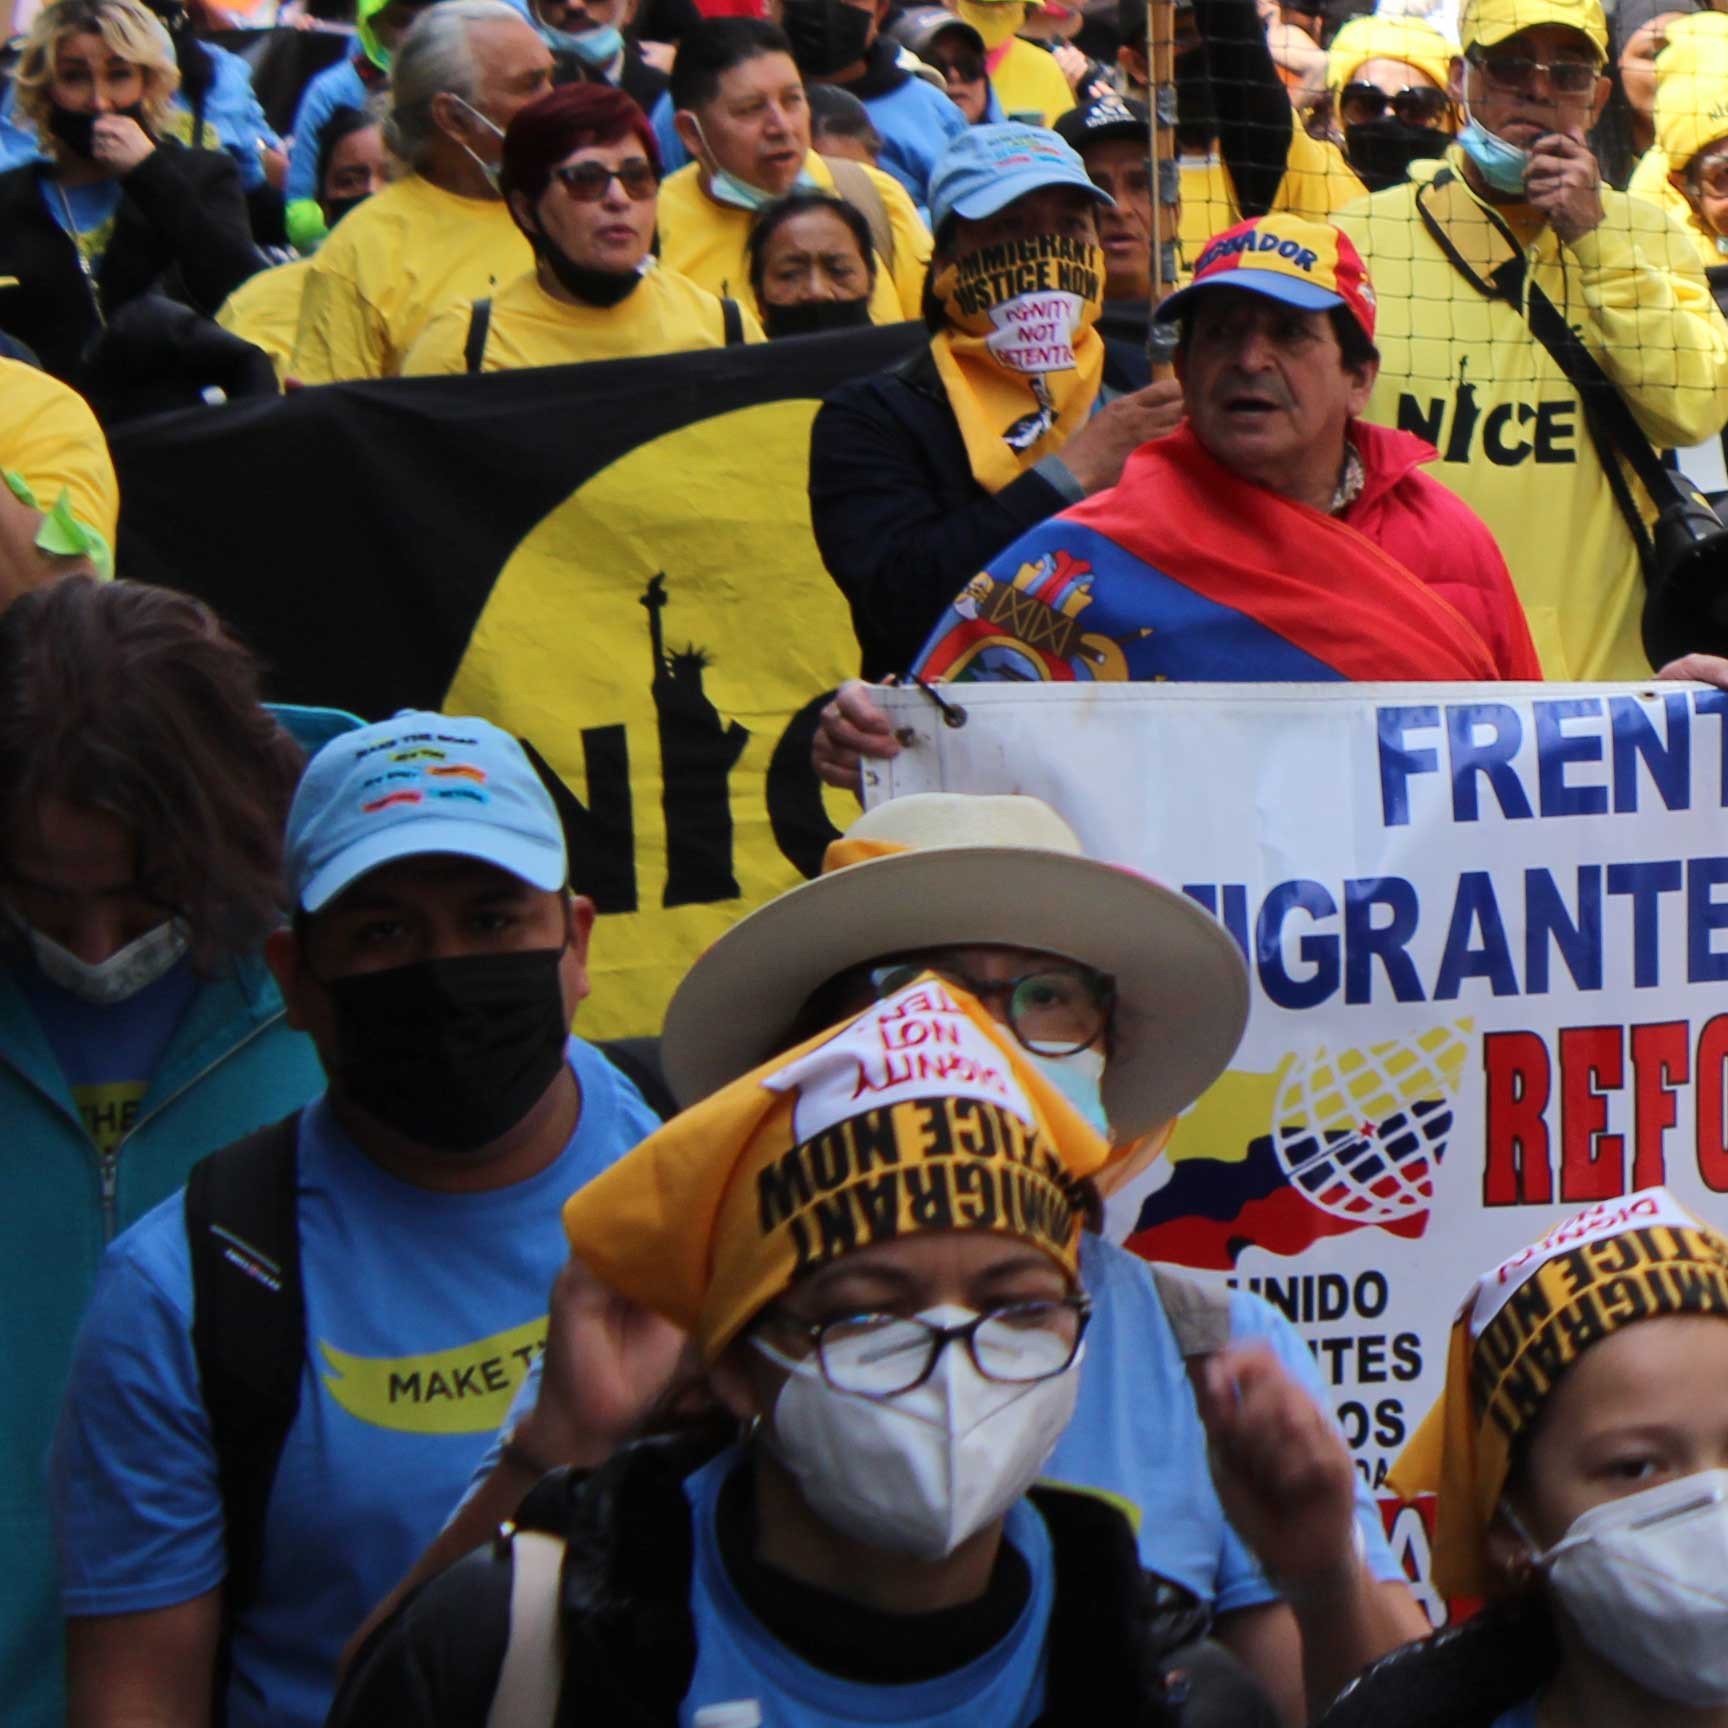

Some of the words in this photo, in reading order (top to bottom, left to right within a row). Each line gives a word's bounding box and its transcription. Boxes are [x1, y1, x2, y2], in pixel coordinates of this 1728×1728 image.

[1018, 323, 1056, 343] NOT
[1397, 372, 1577, 467] NICE
[757, 1107, 900, 1236] NOW
[388, 1356, 511, 1404] MAKE
